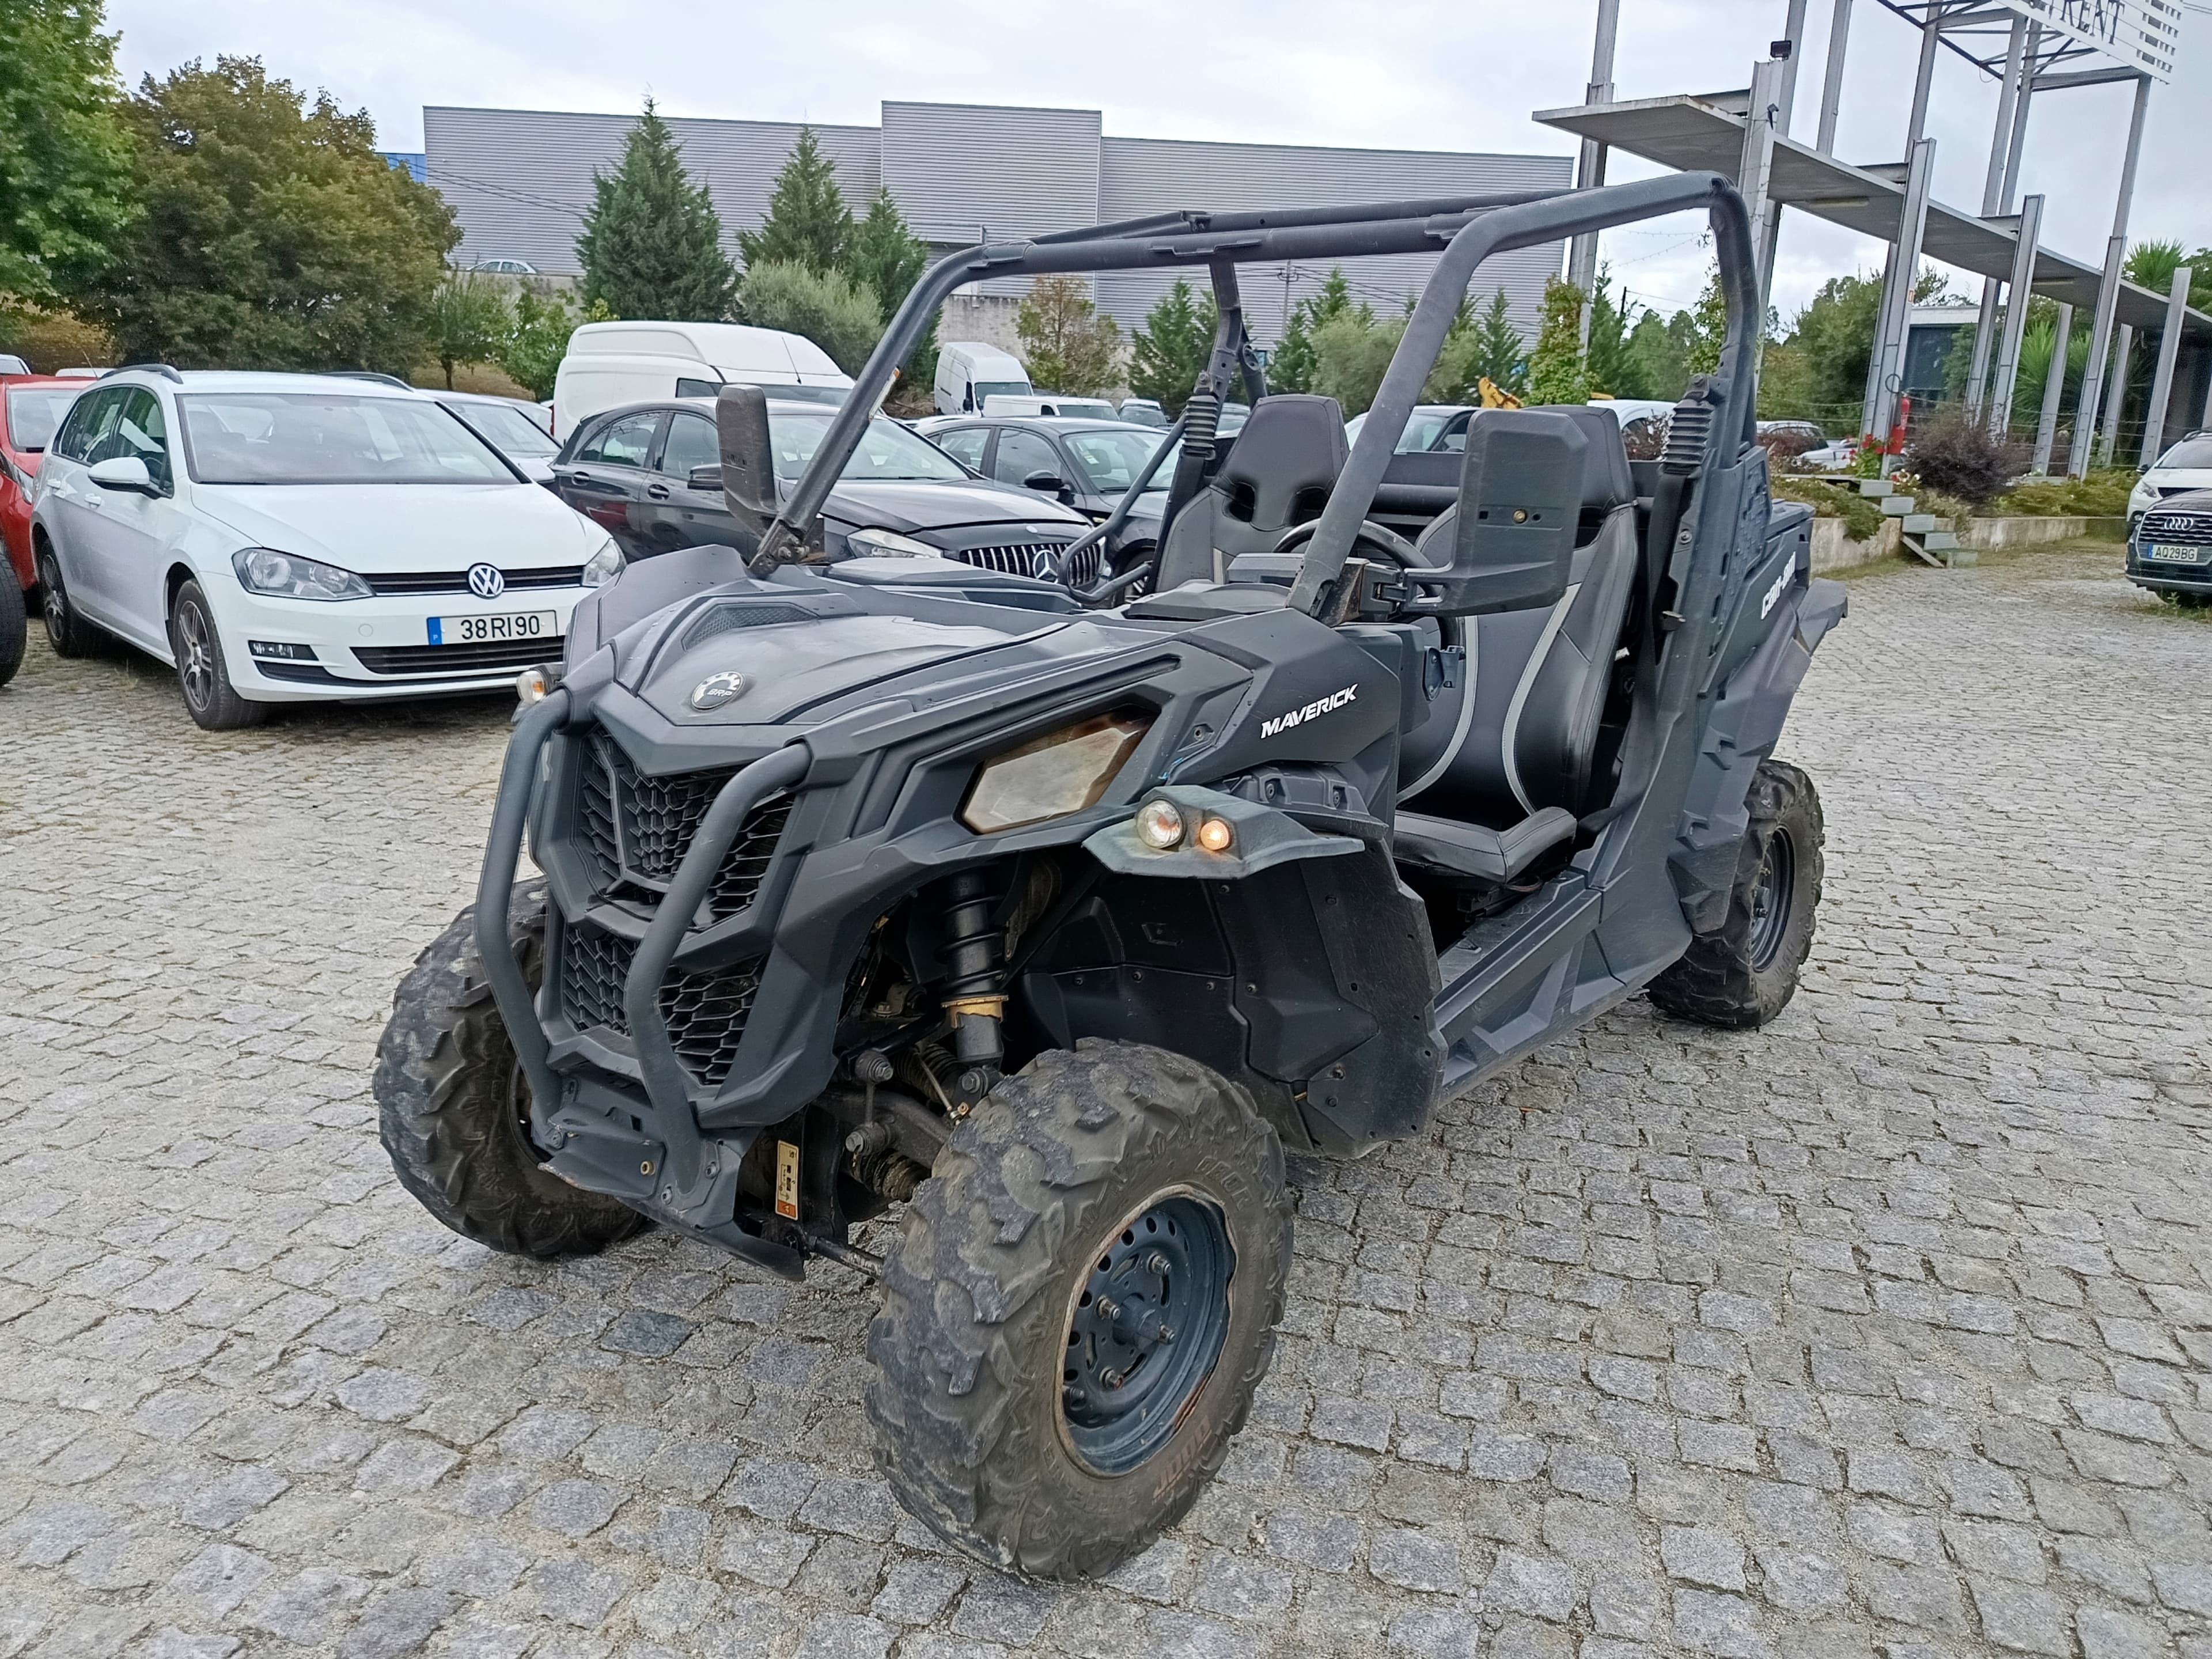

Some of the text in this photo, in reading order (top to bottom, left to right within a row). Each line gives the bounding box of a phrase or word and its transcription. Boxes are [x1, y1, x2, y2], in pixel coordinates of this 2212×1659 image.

[2155, 546, 2195, 560] AQ29BG
[460, 615, 540, 640] 38RI90
[707, 688, 733, 697] BRP
[1260, 683, 1358, 739] MAVERICK
